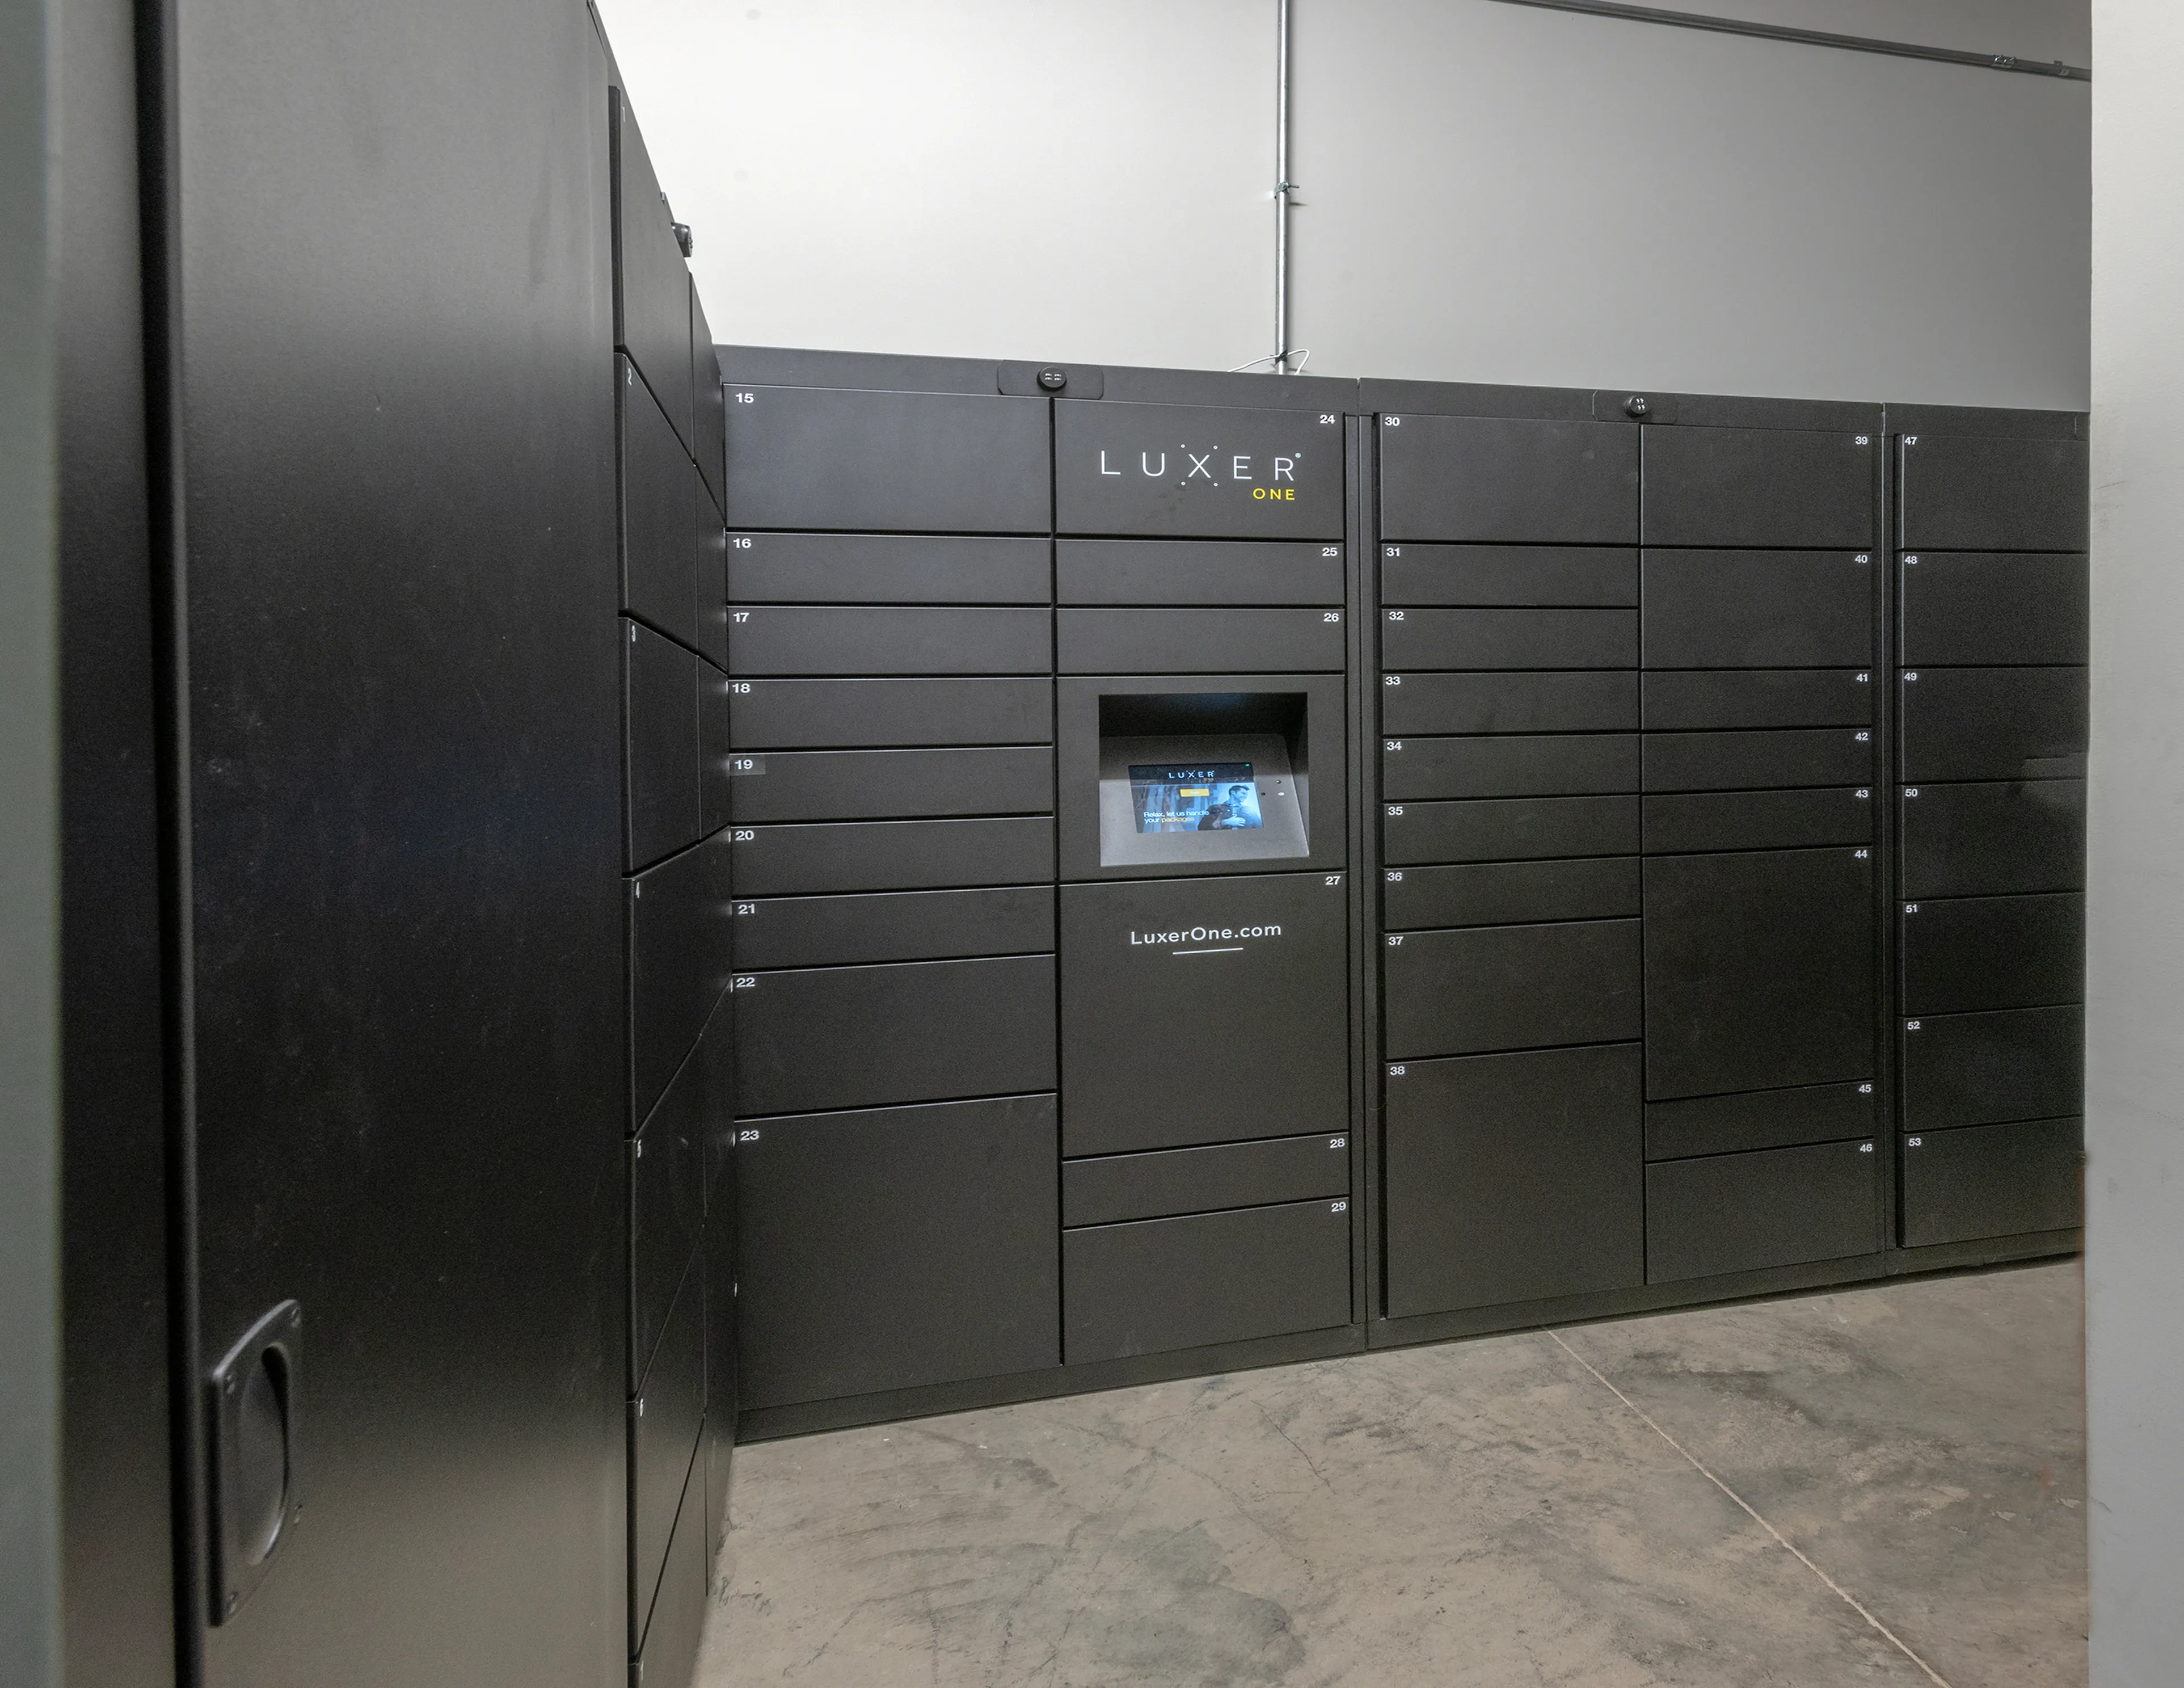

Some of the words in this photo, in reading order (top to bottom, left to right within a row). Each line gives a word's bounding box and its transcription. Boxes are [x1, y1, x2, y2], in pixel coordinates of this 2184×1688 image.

[735, 393, 754, 403] 15
[1319, 414, 1335, 424] 24
[1384, 416, 1400, 427] 30
[1855, 436, 1868, 445] 39
[1904, 436, 1917, 445] 47
[1101, 450, 1295, 481] LUXER
[1253, 488, 1296, 500] ONE
[733, 538, 752, 549] 16
[1322, 547, 1338, 557] 25
[1386, 547, 1400, 557] 31
[1854, 554, 1868, 563] 40
[1904, 555, 1917, 565] 48
[733, 612, 749, 622] 17
[1323, 612, 1339, 622] 26
[1389, 611, 1404, 621] 32
[1385, 676, 1401, 685] 33
[1856, 673, 1868, 682] 41
[1904, 672, 1917, 681] 49
[732, 683, 751, 693] 18
[1855, 732, 1869, 741] 42
[1386, 741, 1402, 751] 34
[735, 759, 753, 770] 19
[1855, 789, 1869, 798] 43
[1905, 788, 1918, 797] 50
[1388, 806, 1403, 816] 35
[735, 830, 755, 841] 20
[1854, 849, 1868, 858] 44
[1325, 875, 1340, 886] 27
[1387, 872, 1402, 882] 36
[738, 903, 755, 915] 21
[1905, 904, 1917, 913] 51
[1131, 925, 1281, 945] LuxerOne.com
[1388, 936, 1403, 946] 37
[736, 977, 756, 988] 22
[1907, 1021, 1920, 1030] 52
[1390, 1066, 1405, 1076] 38
[1858, 1084, 1872, 1093] 45
[740, 1130, 760, 1141] 23
[1330, 1138, 1345, 1148] 28
[1908, 1137, 1921, 1147] 53
[1860, 1143, 1873, 1152] 46
[1331, 1201, 1347, 1213] 29
